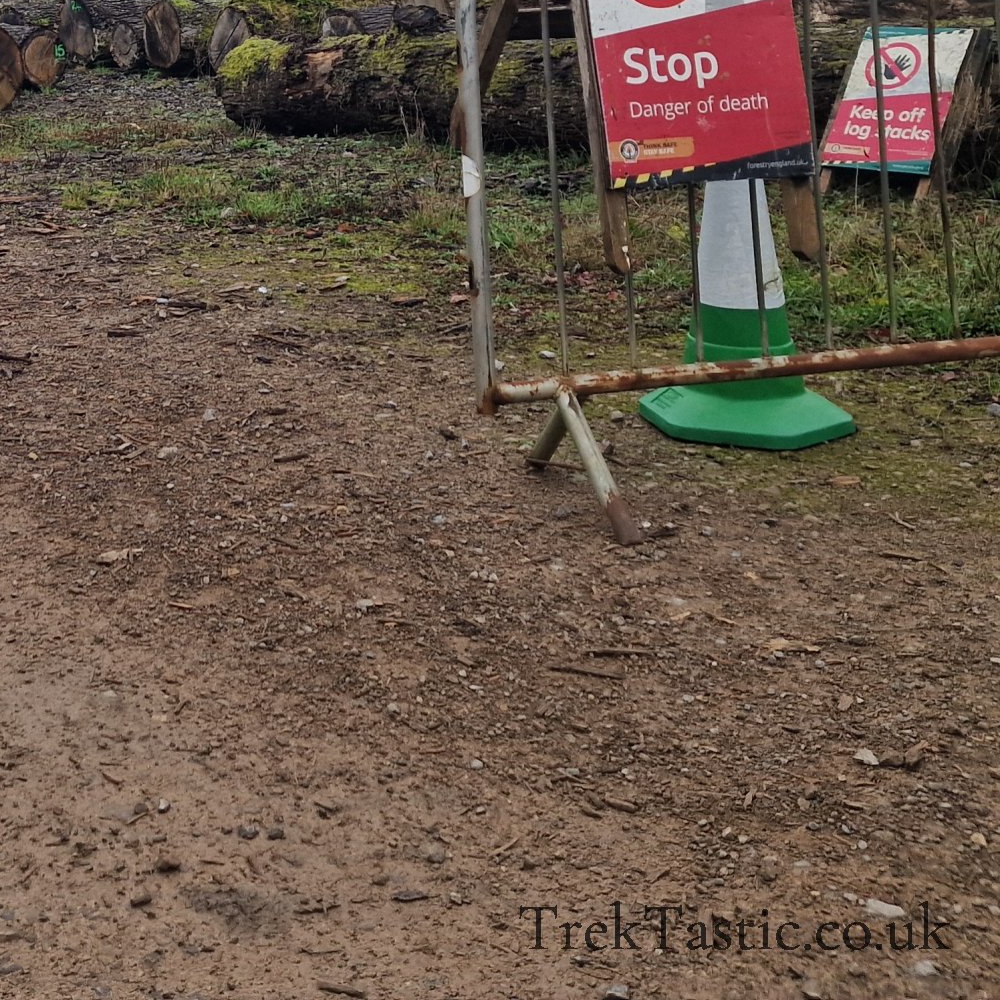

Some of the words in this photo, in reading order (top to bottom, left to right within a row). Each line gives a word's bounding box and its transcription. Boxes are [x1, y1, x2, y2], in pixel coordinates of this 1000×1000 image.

[623, 47, 719, 88] Stop
[629, 101, 691, 120] Danger
[697, 95, 714, 113] of
[719, 92, 769, 112] death
[899, 107, 926, 123] off
[843, 120, 871, 139] log
